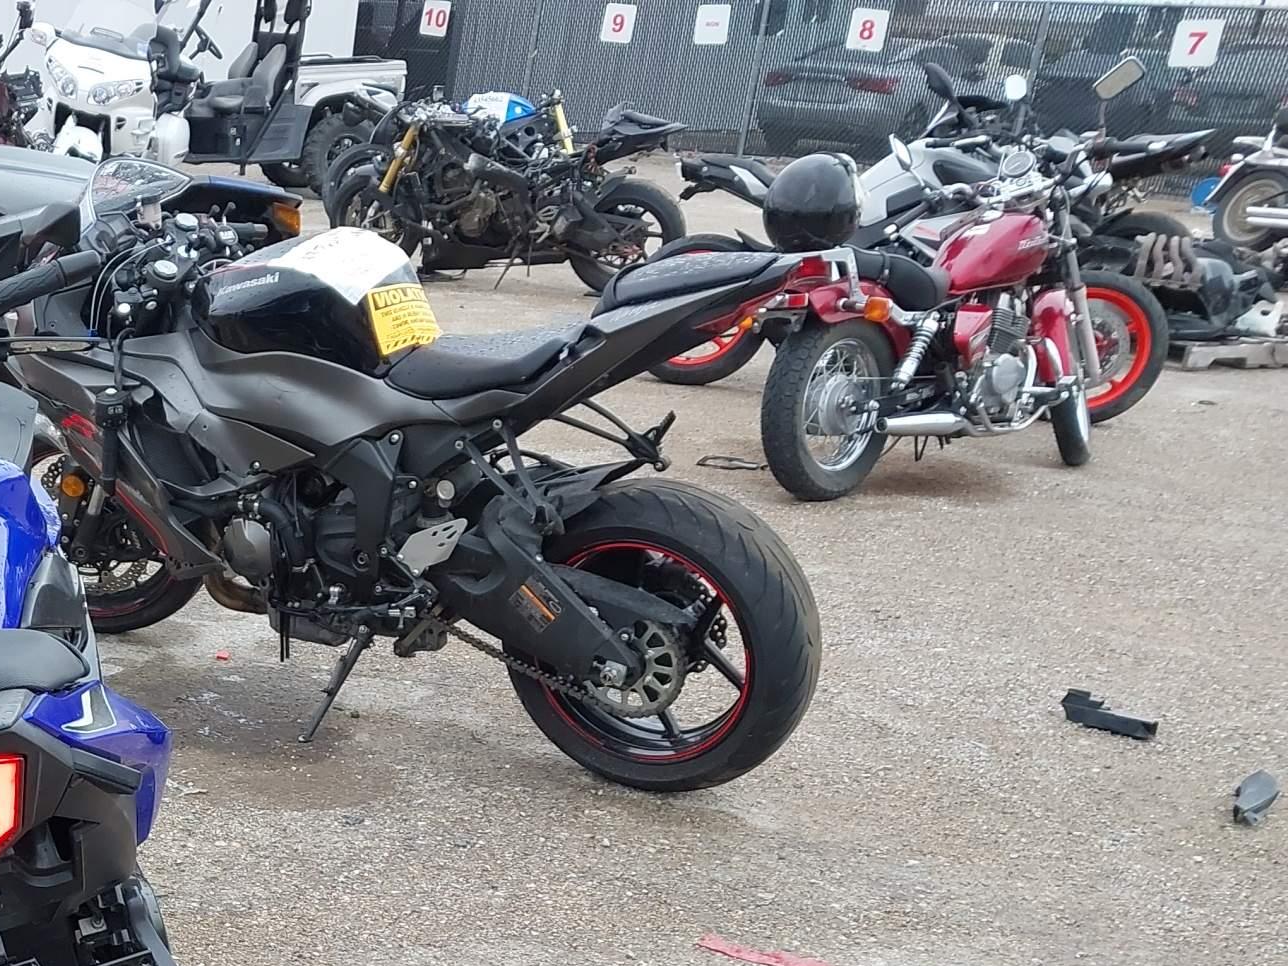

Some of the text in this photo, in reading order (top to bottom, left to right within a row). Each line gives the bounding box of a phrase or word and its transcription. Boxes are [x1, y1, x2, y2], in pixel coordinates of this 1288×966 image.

[425, 8, 447, 28] 10
[612, 13, 625, 33] 9
[859, 19, 875, 40] 8
[1188, 31, 1209, 55] 7
[217, 271, 280, 296] Kawasaki
